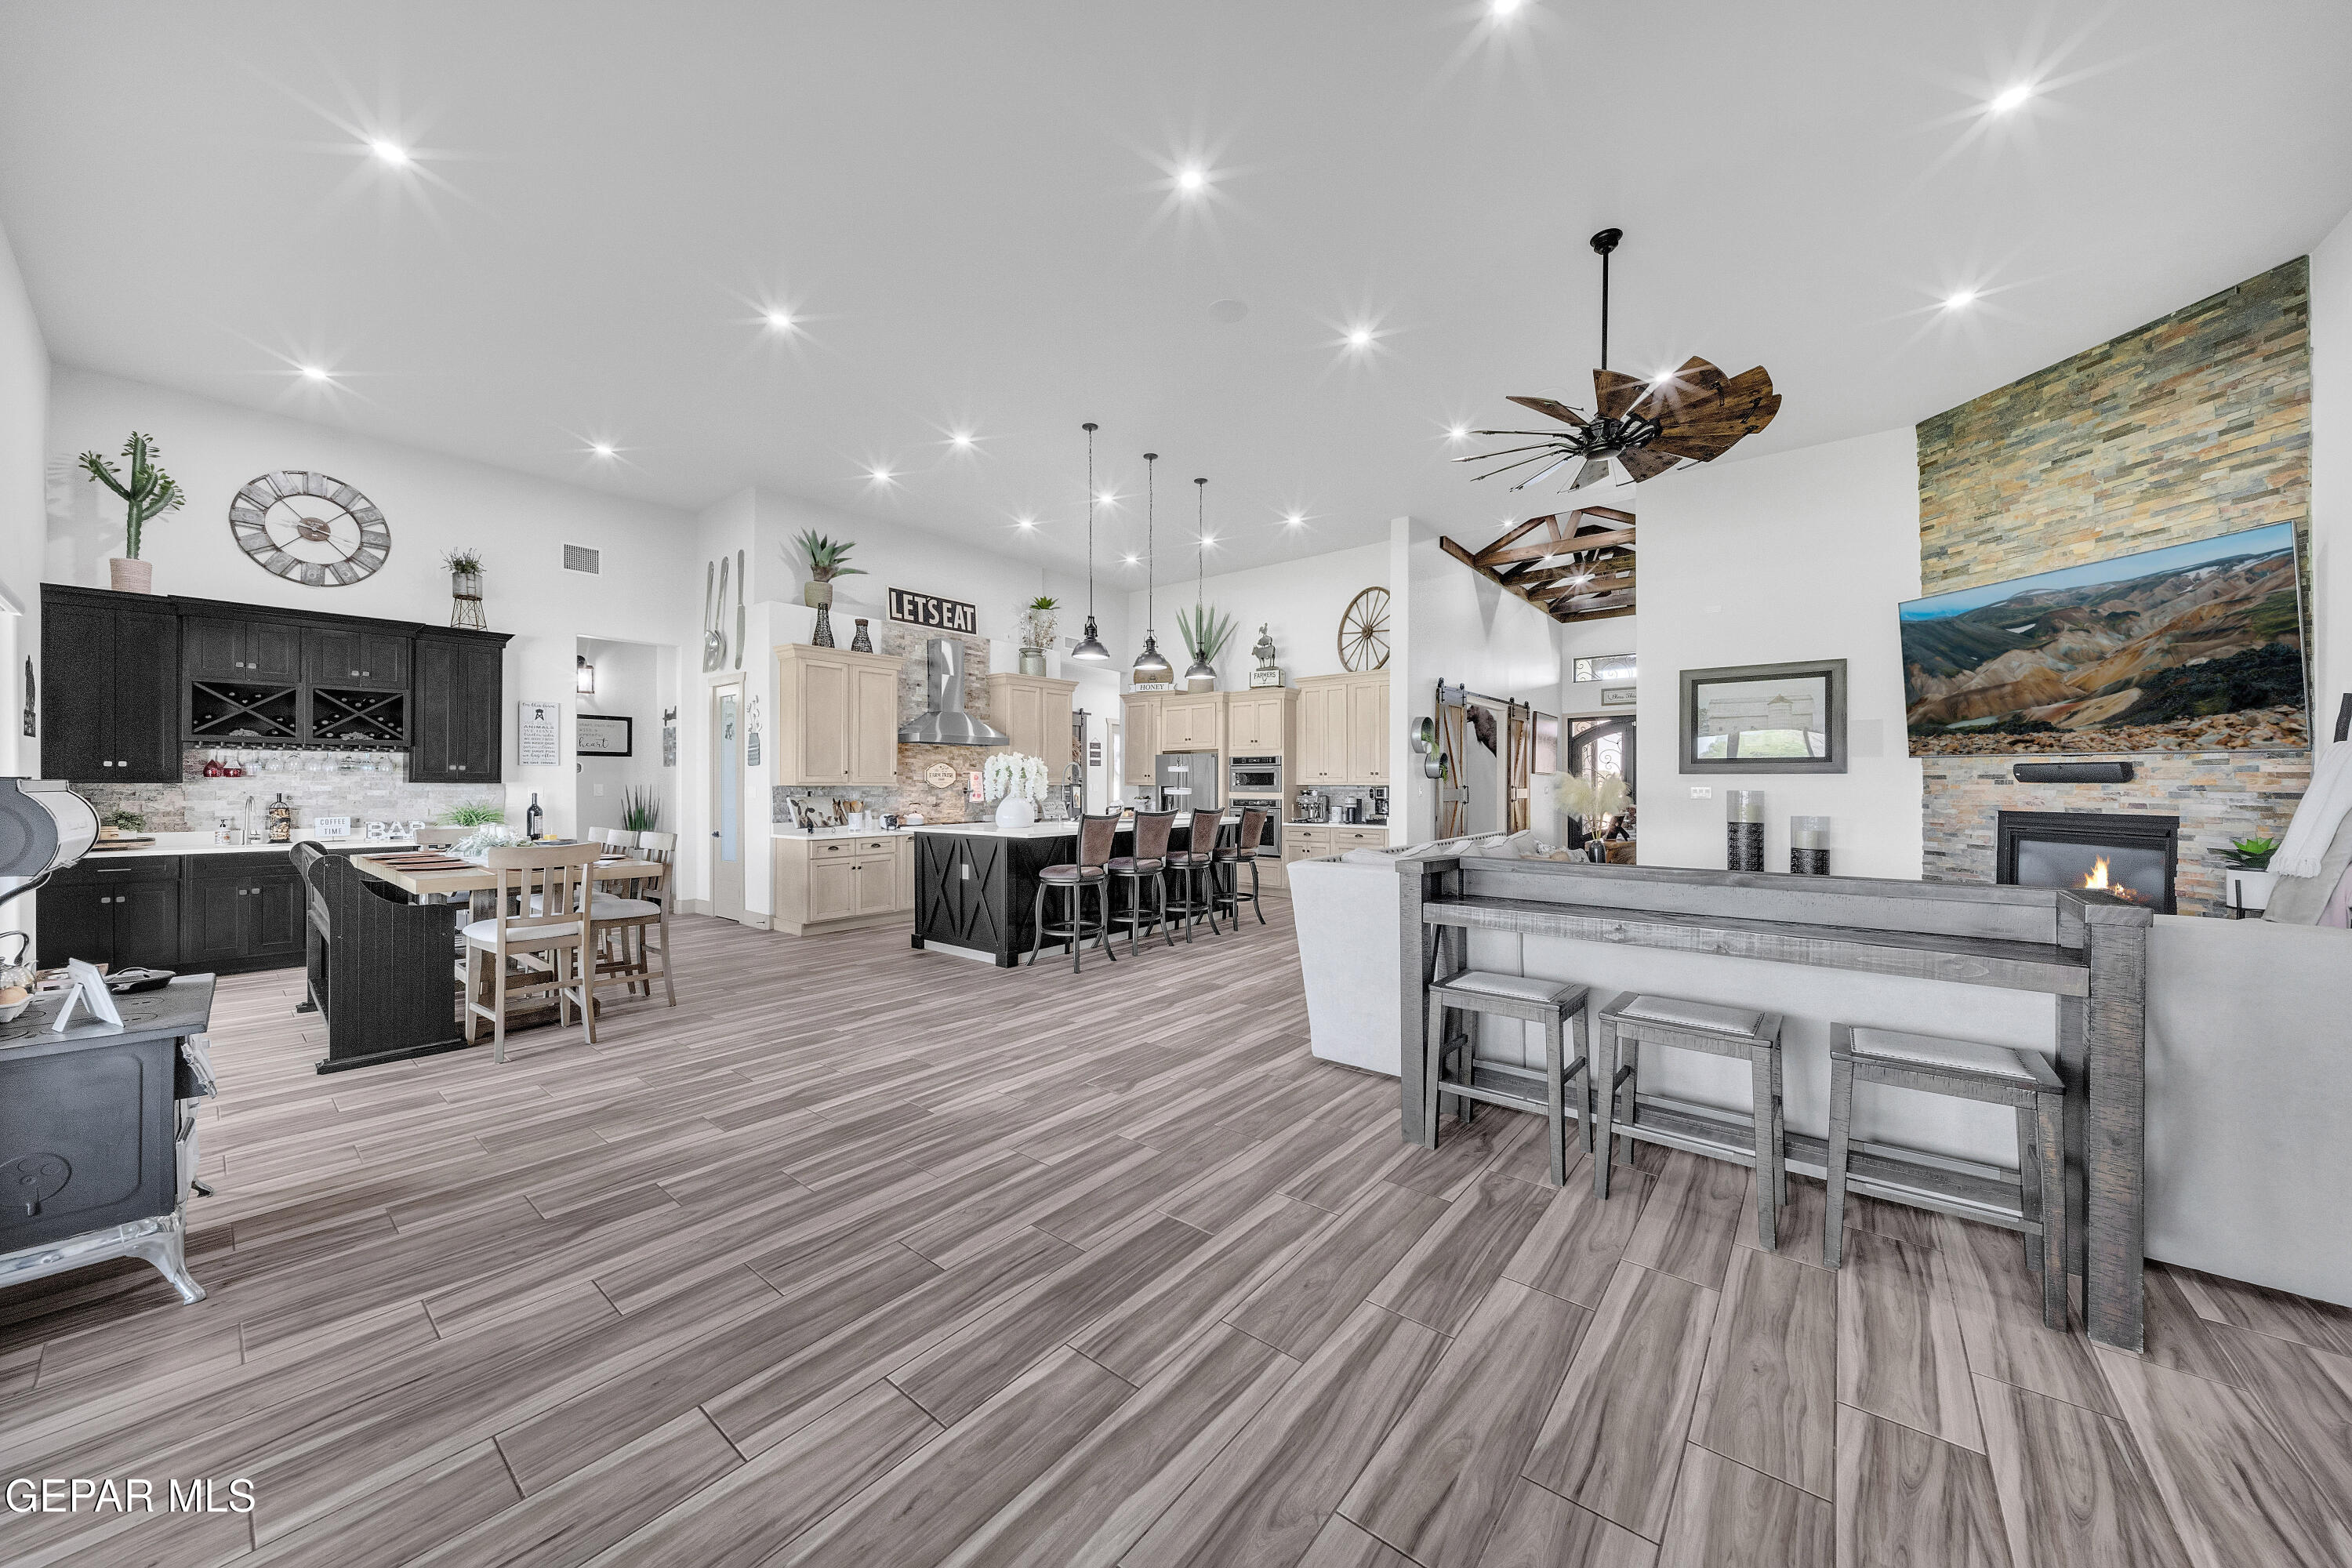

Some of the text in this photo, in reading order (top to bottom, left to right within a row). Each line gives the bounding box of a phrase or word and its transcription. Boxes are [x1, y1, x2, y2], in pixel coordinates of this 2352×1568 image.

[891, 591, 975, 632] LET'S EAT
[579, 736, 609, 749] heart
